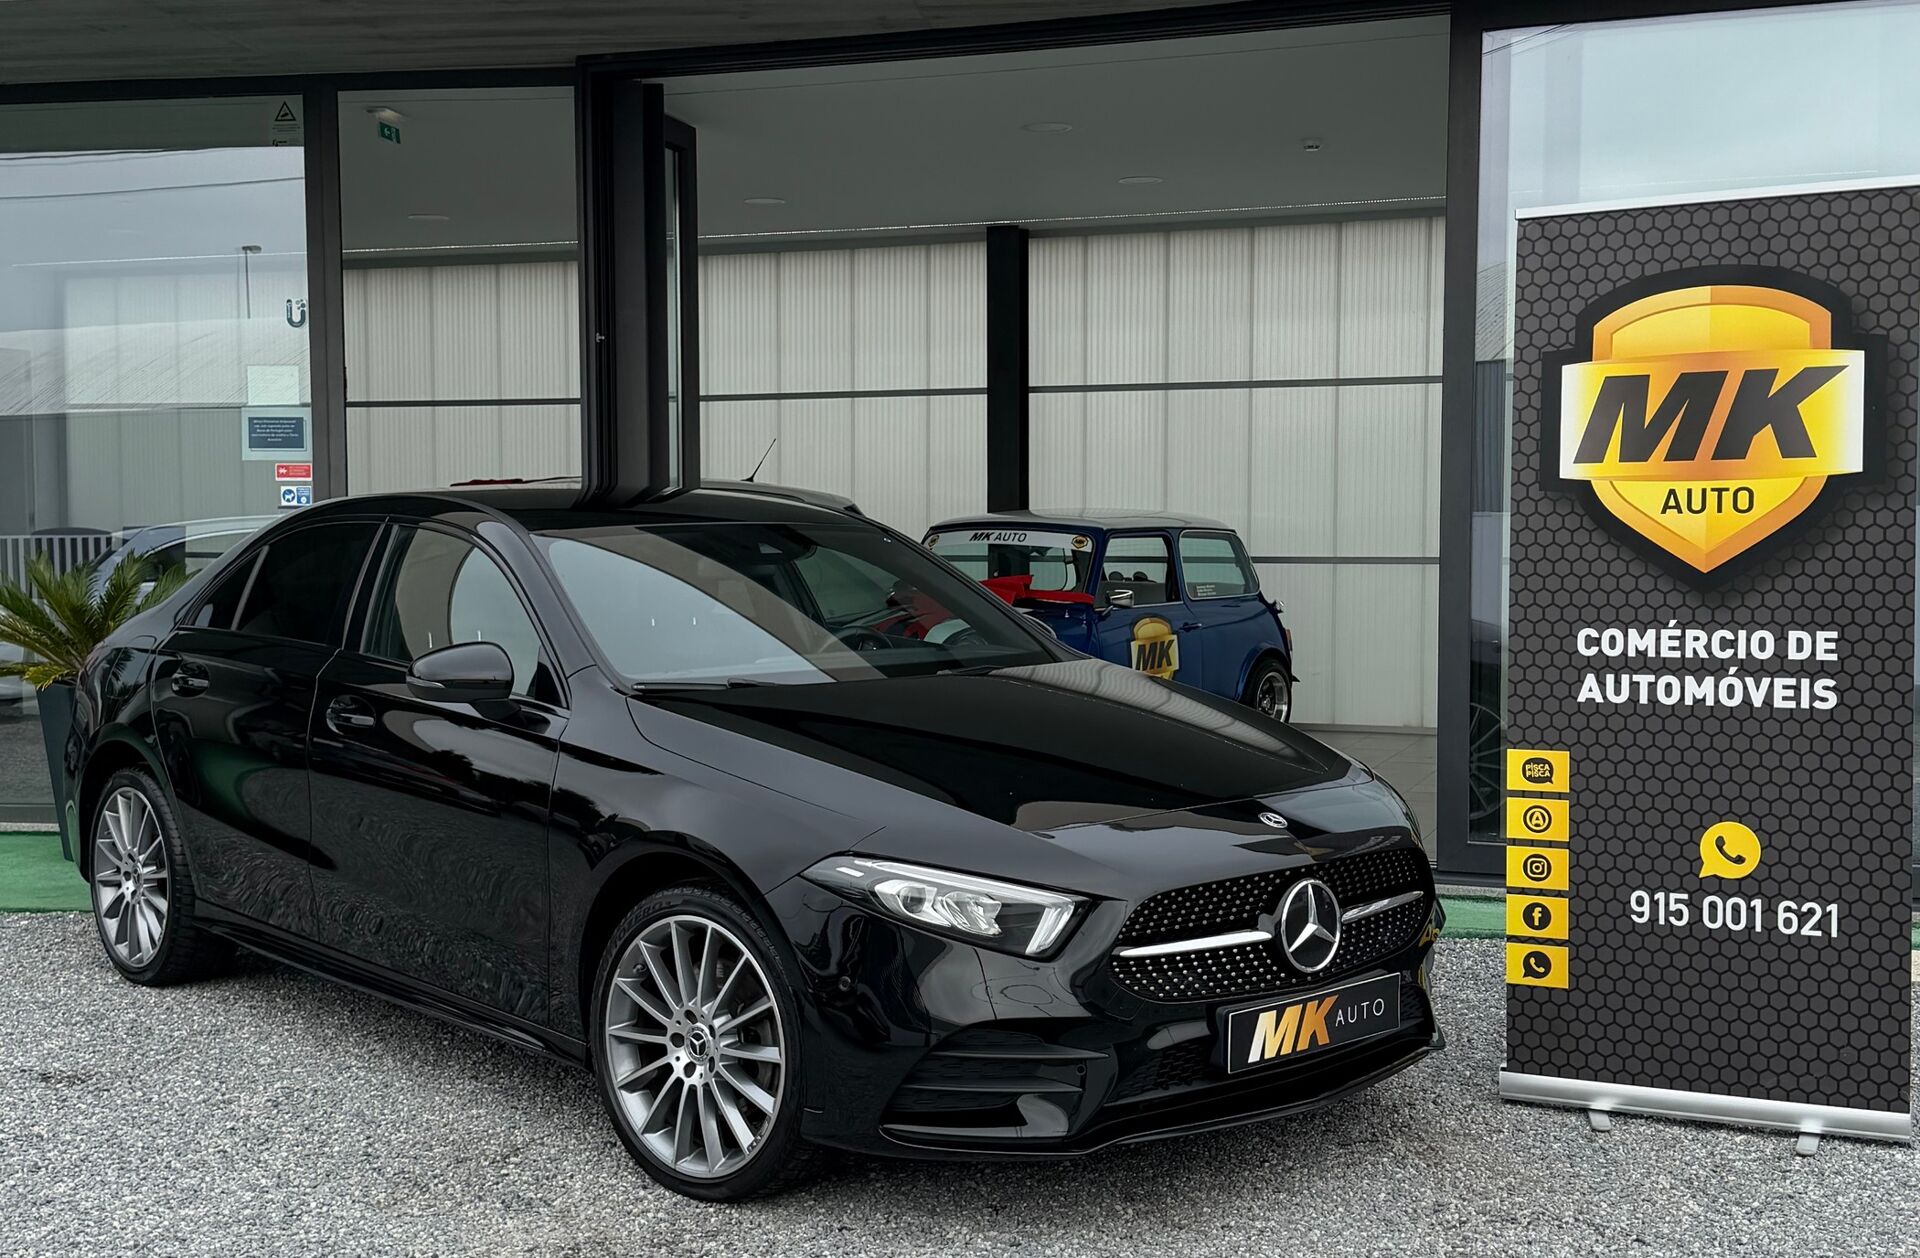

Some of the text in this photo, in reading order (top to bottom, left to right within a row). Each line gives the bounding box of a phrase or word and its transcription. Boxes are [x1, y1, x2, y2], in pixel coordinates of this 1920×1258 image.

[1573, 364, 1849, 464] MK
[1660, 486, 1755, 515] AUTO
[968, 531, 1027, 543] MK AUTO
[1135, 638, 1176, 671] MK
[1576, 619, 1839, 661] COMÉRCIO DE
[1576, 666, 1839, 710] AUTOMÓVEIS
[1630, 890, 1839, 938] 915 001 621
[1247, 993, 1385, 1063] MK AUTO
